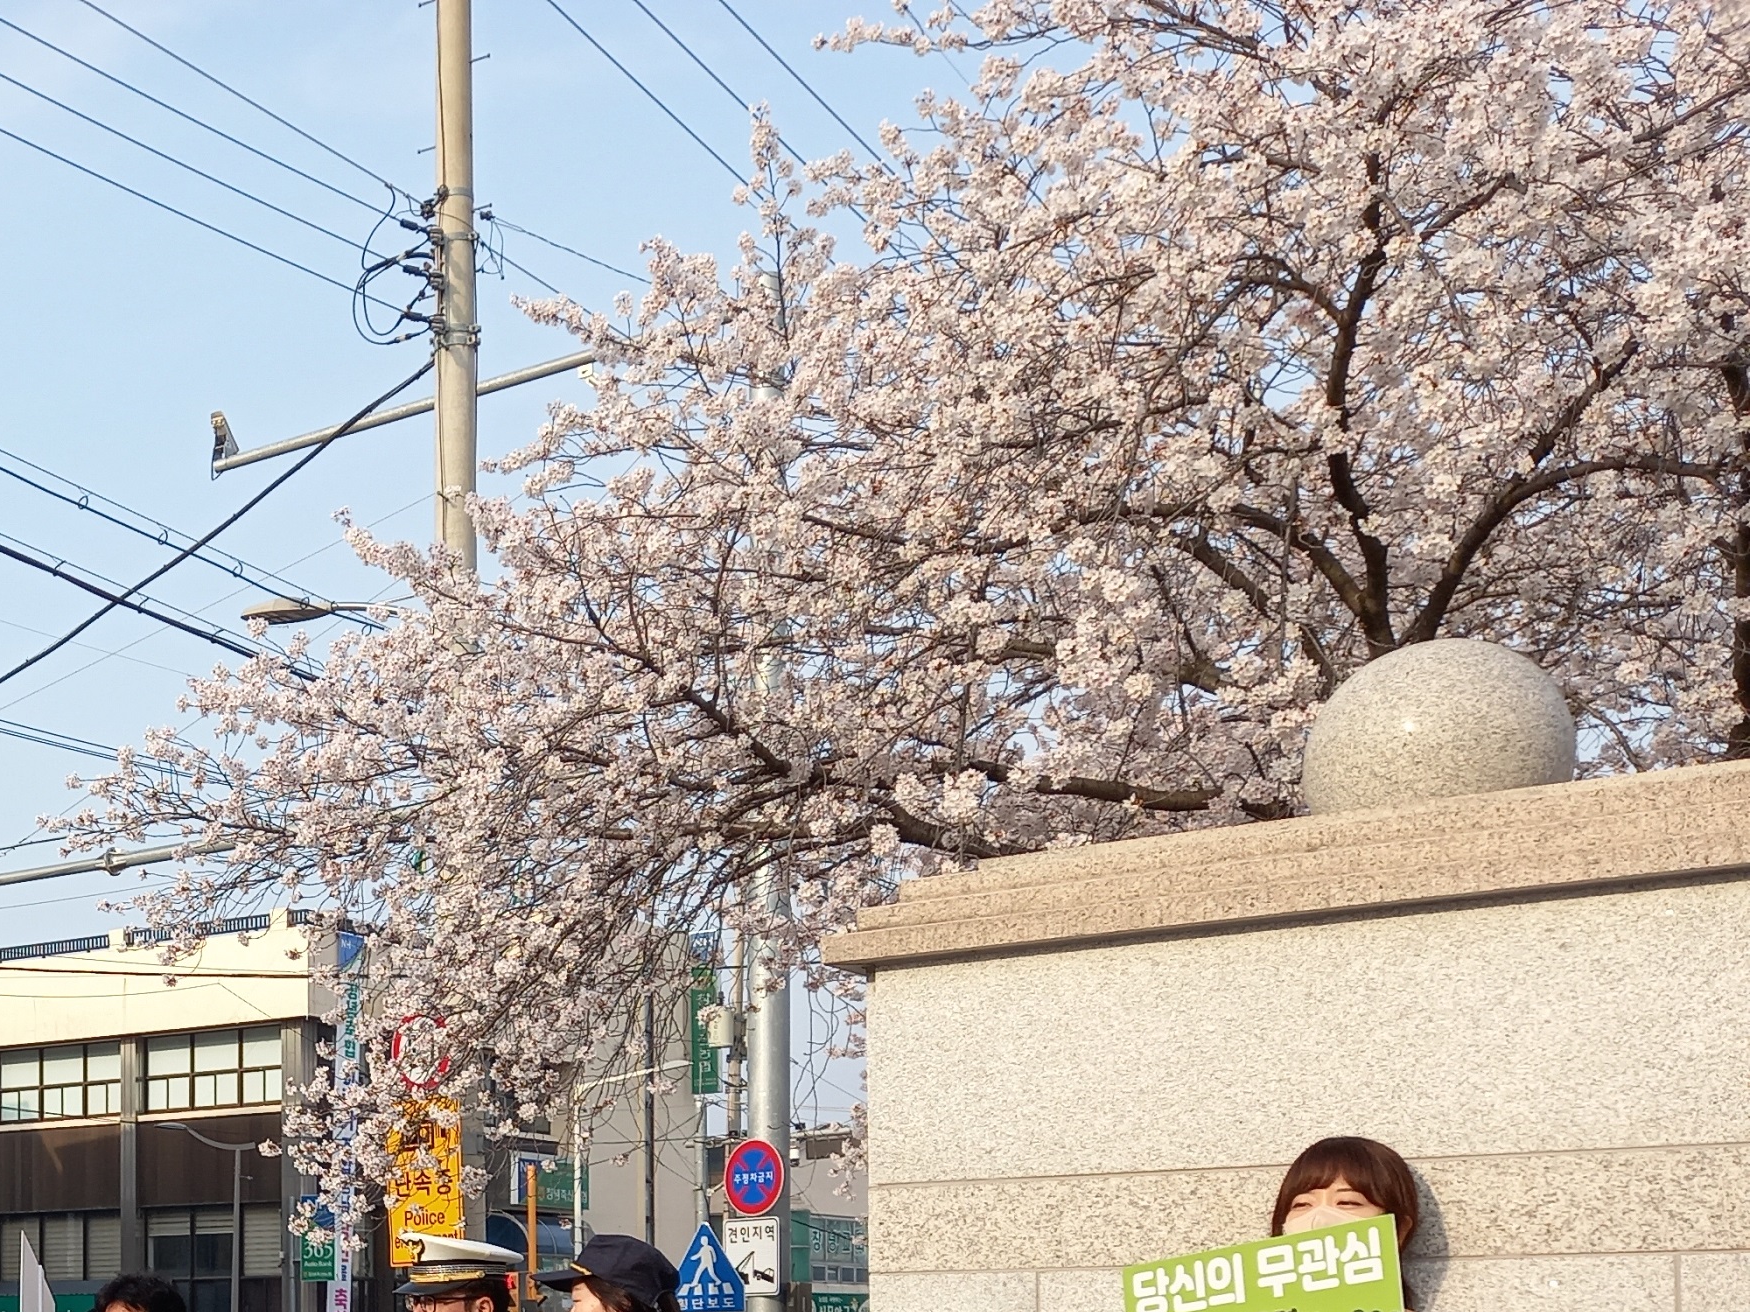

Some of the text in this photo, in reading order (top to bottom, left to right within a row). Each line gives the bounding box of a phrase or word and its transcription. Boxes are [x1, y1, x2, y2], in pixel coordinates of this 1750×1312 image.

[733, 1170, 774, 1185] 주정차금지
[404, 1210, 445, 1227] Police
[728, 1224, 775, 1244] 견인지역
[1256, 1226, 1384, 1298] 무관심
